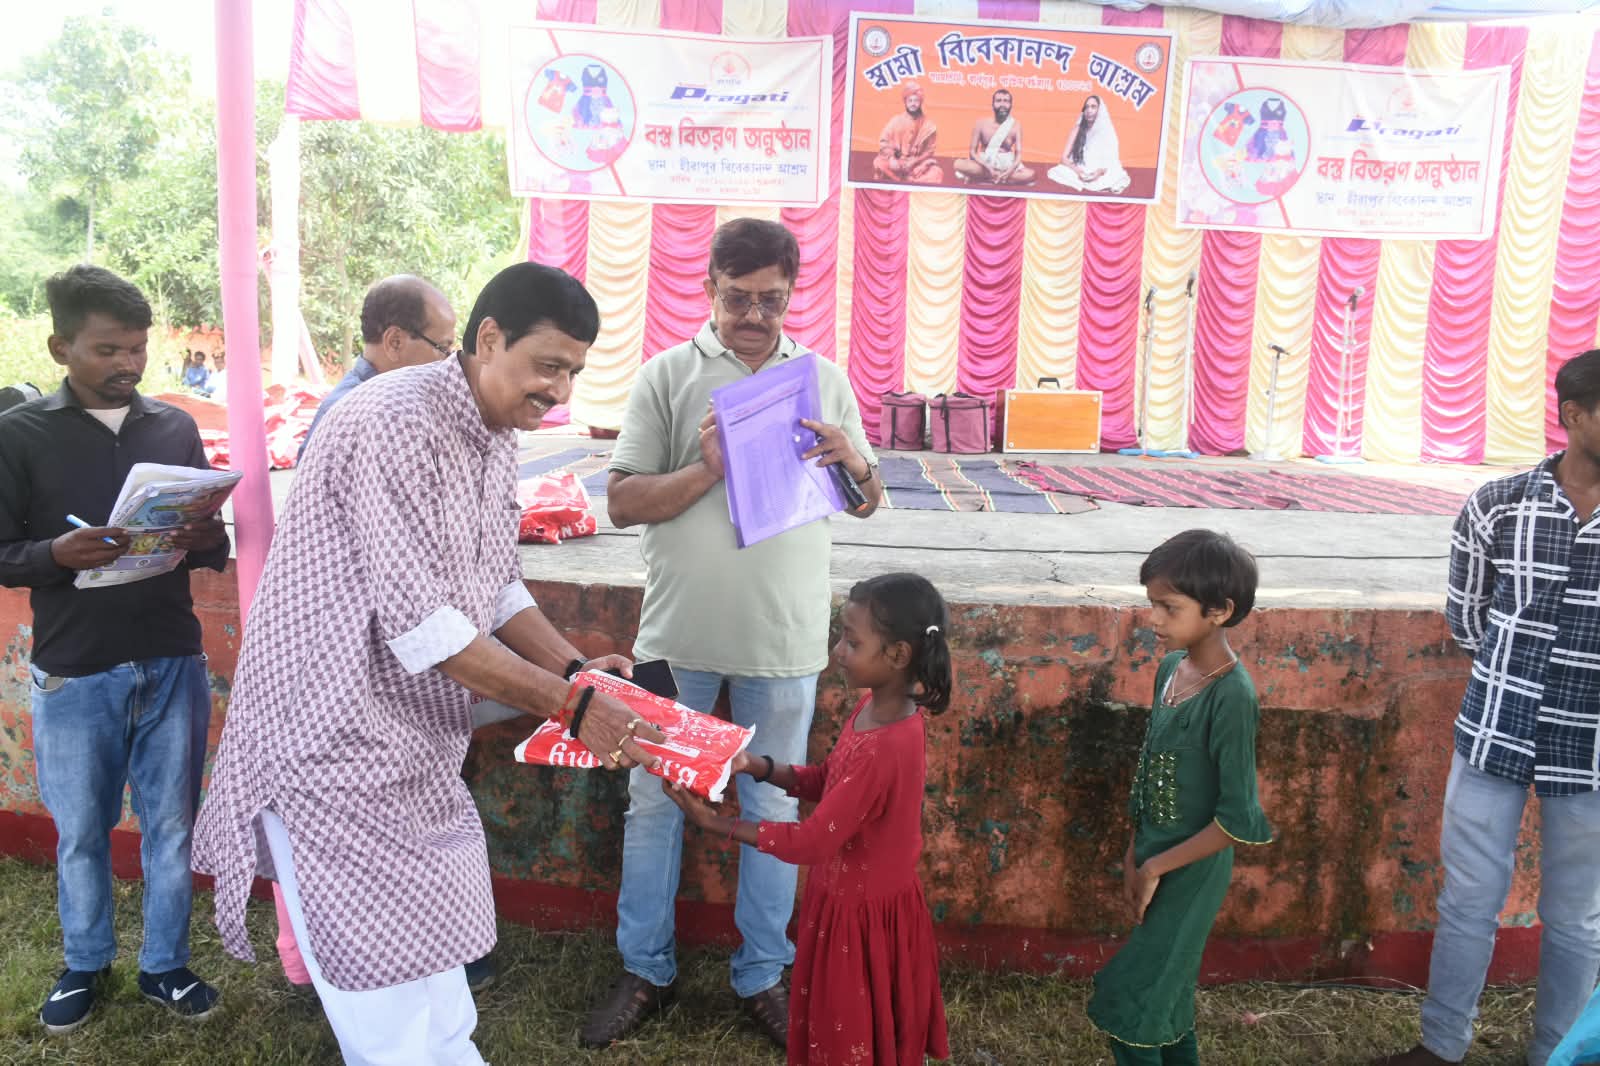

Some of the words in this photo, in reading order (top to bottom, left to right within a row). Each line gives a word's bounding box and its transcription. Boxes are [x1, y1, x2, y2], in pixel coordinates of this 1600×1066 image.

[865, 47, 922, 88] স্বামী
[938, 33, 1074, 71] বিবেকানন্দ
[1089, 53, 1154, 107] আশ্রম
[670, 86, 788, 104] Pragati
[644, 123, 673, 149] বস্ত্র
[679, 117, 737, 152] বিতরণ
[744, 120, 811, 156] অনুষ্ঠান
[1350, 149, 1411, 185] বিতরণ
[1414, 153, 1480, 190] অনুষ্ঠান
